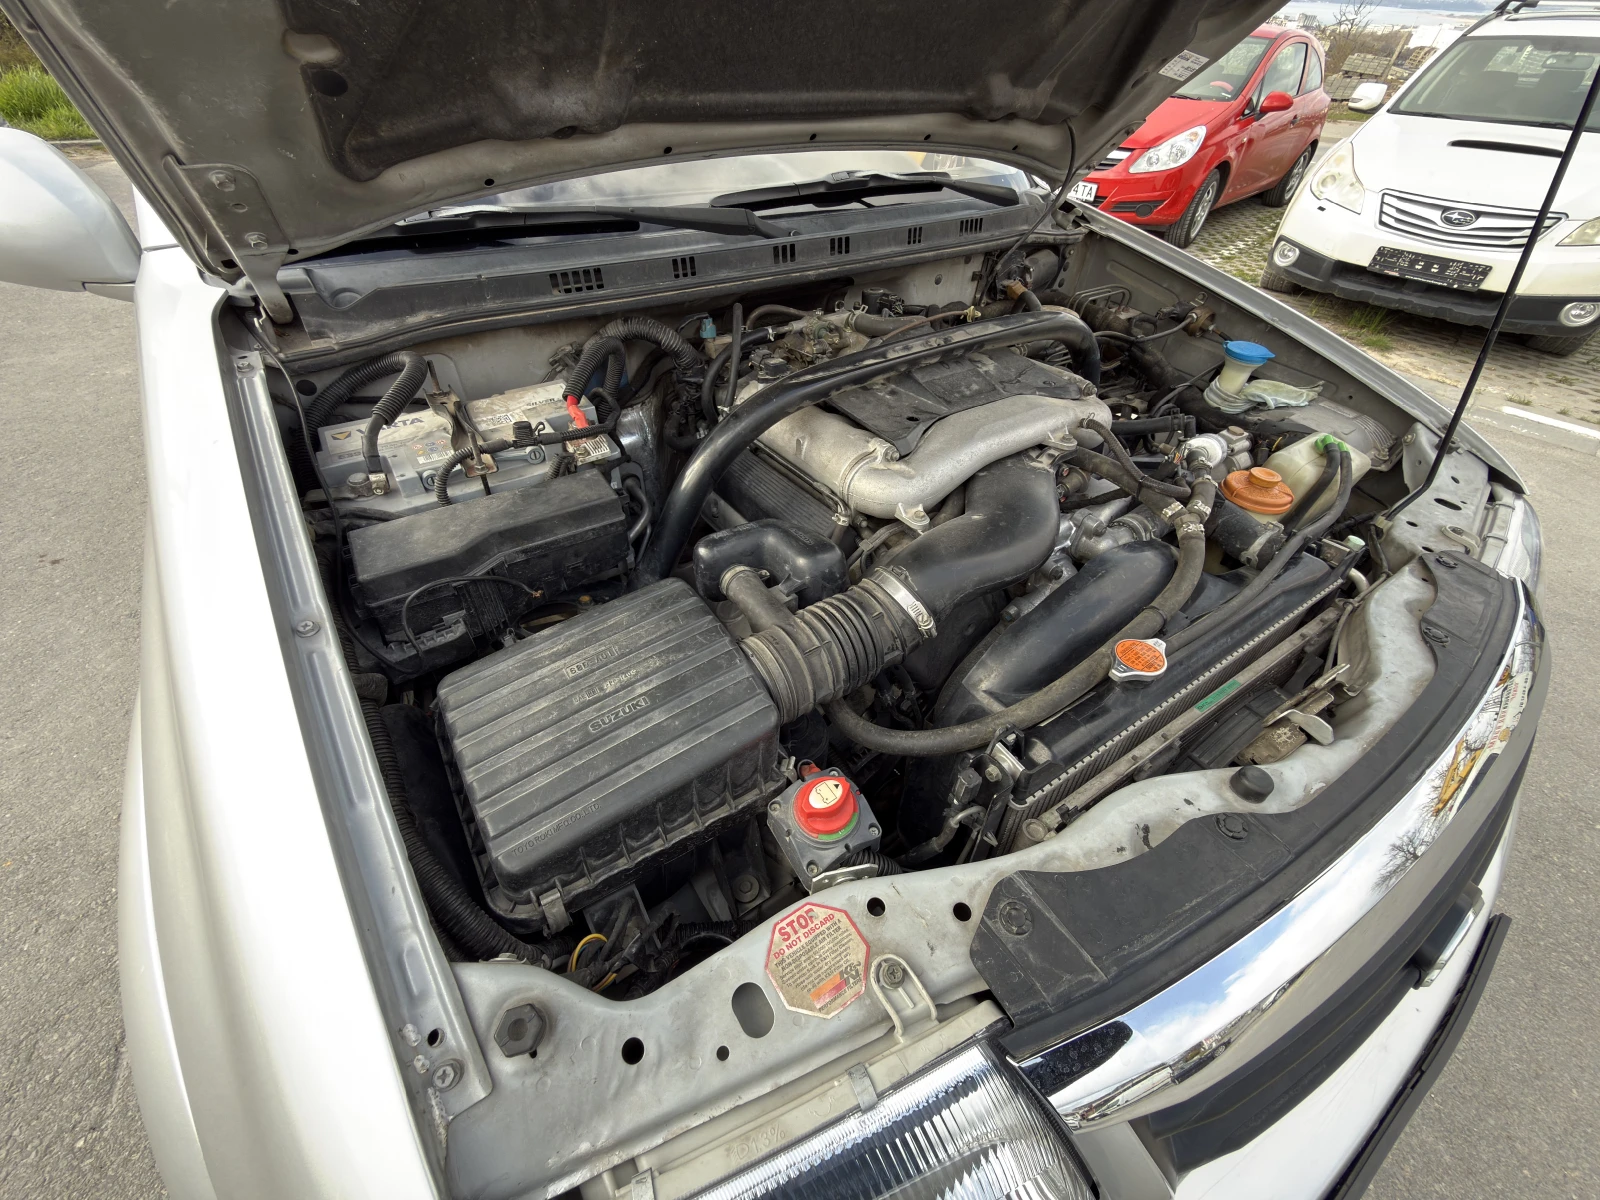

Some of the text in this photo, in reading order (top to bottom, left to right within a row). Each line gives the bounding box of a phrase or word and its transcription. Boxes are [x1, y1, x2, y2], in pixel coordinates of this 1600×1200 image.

[1081, 184, 1092, 197] TA
[588, 696, 650, 732] SUZUKI
[512, 840, 535, 855] TOYO
[535, 829, 554, 843] ROKI
[773, 913, 834, 958] DO NOT DISCARD
[786, 945, 804, 959] VEHICLE
[805, 929, 825, 945] EQUIPPED
[825, 921, 837, 931] WITH
[818, 936, 827, 944] AIR
[826, 926, 840, 937] FILTER
